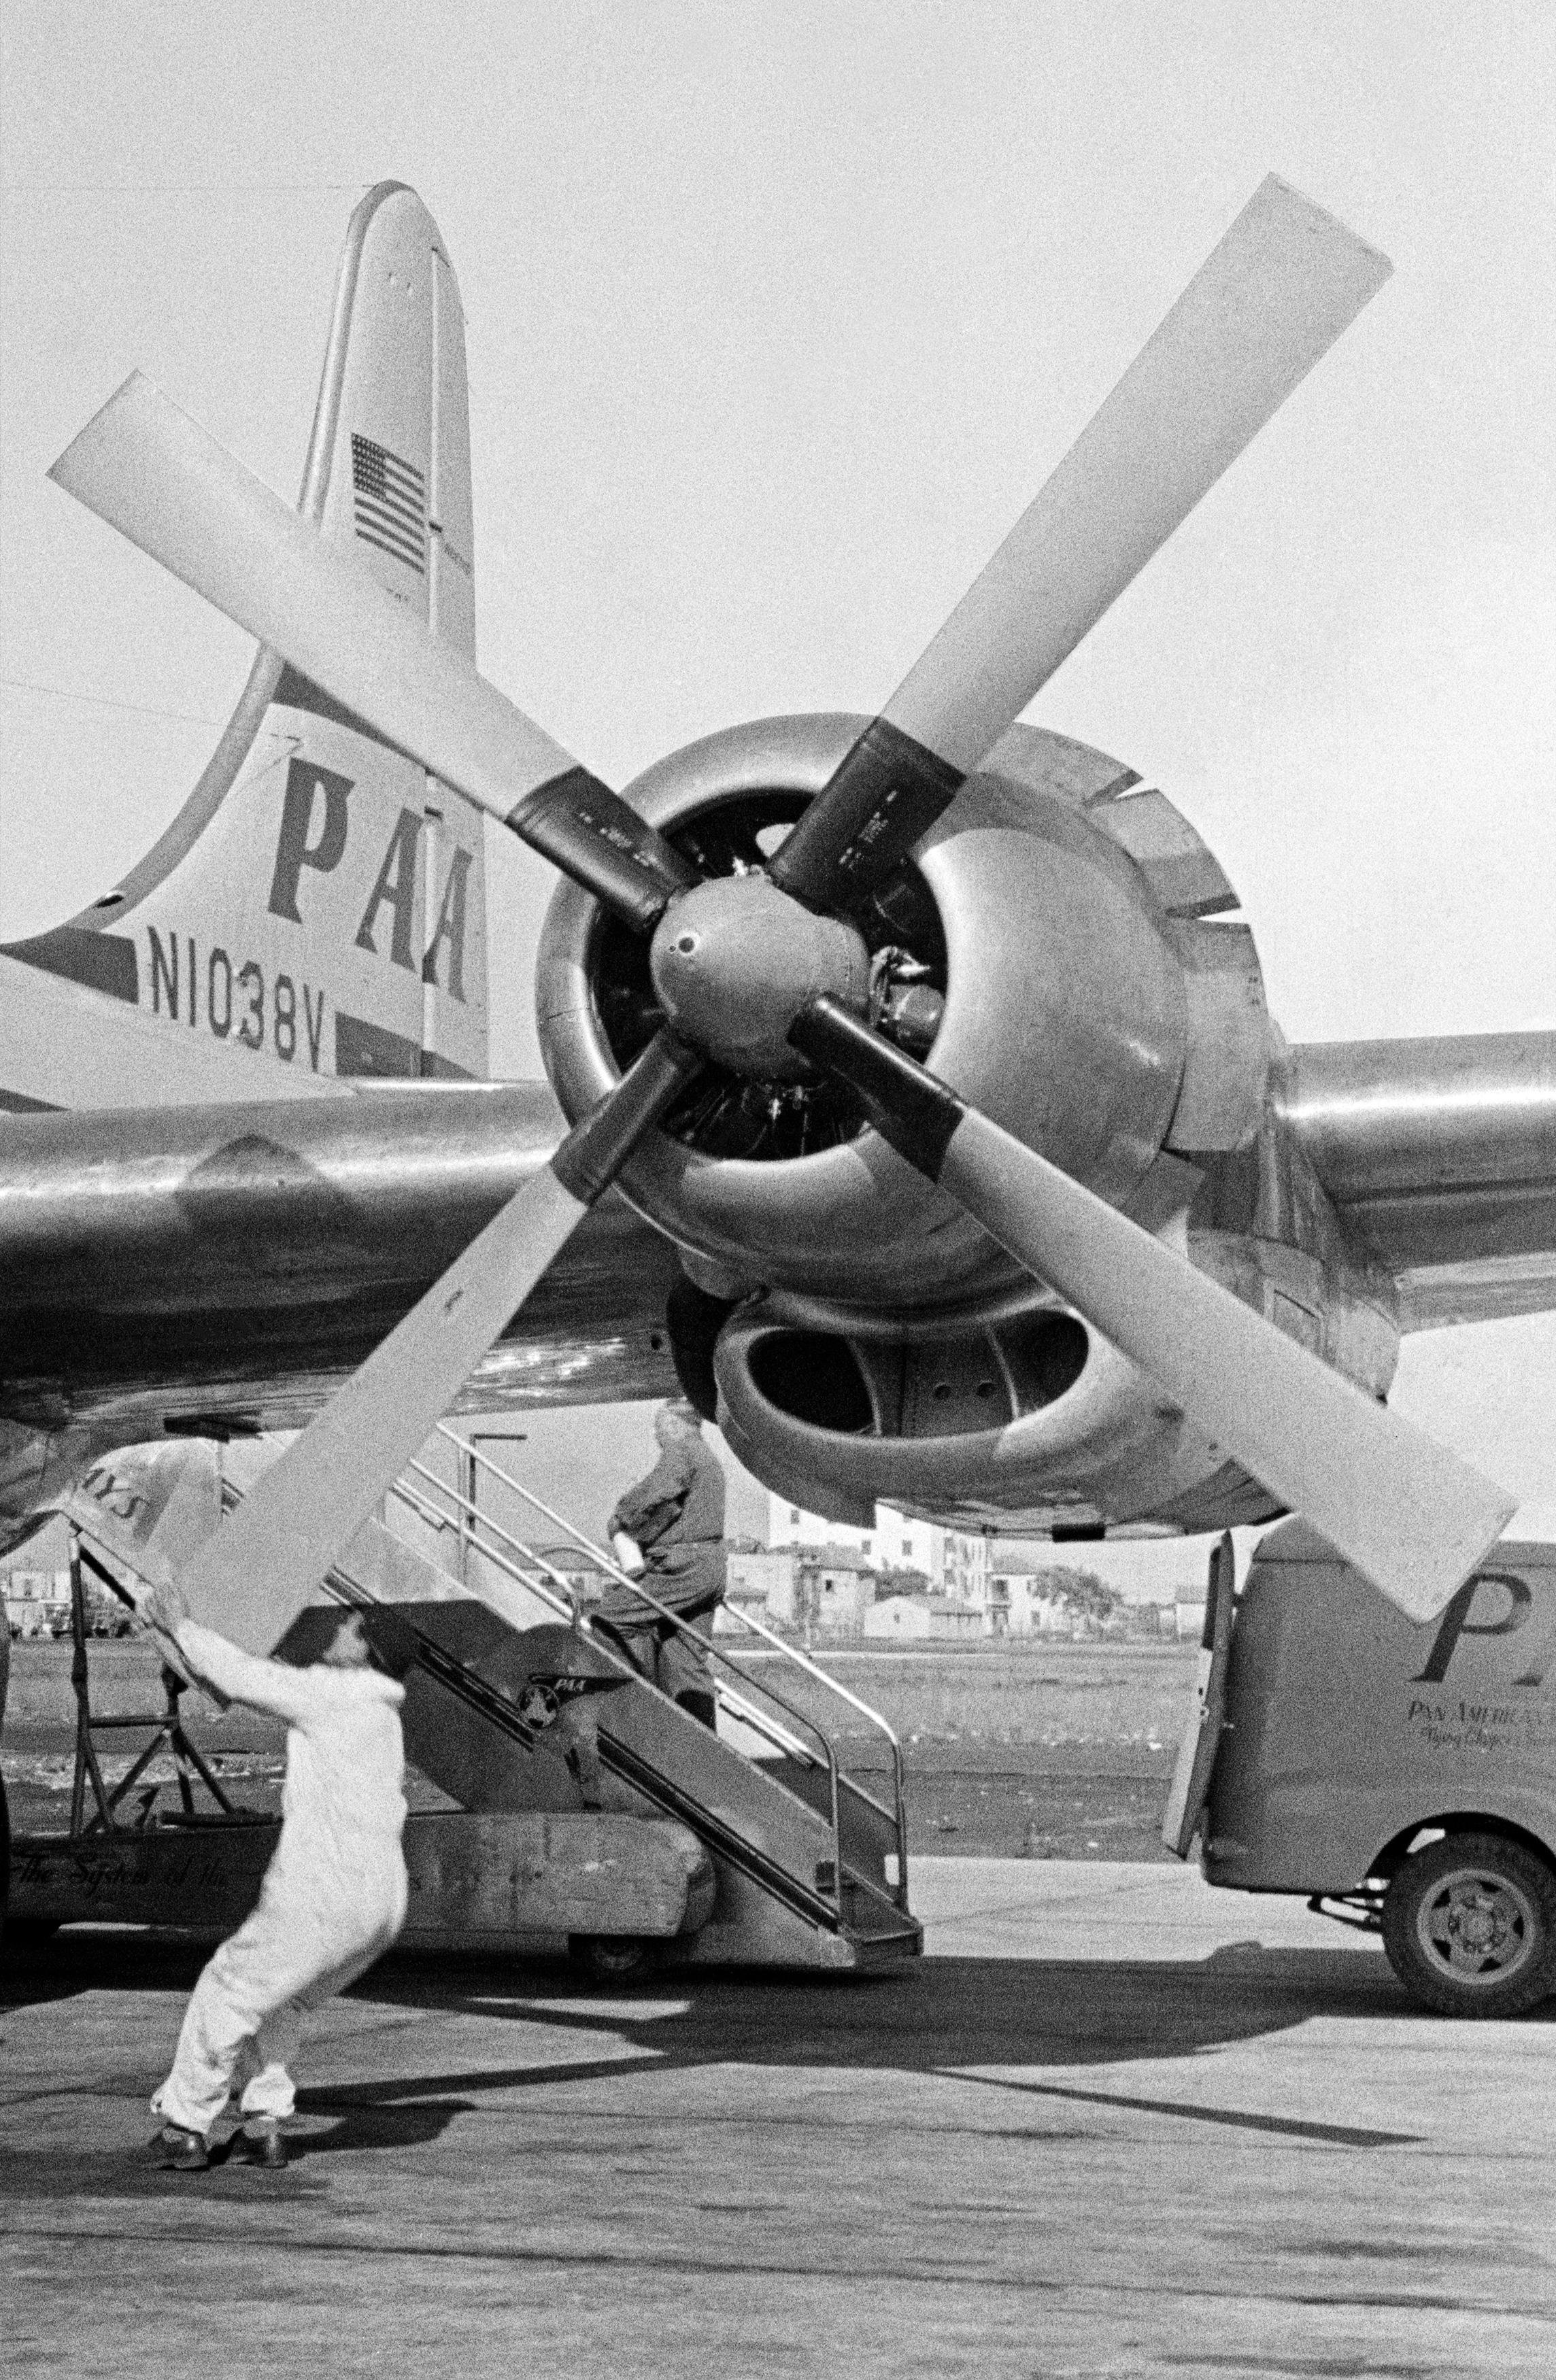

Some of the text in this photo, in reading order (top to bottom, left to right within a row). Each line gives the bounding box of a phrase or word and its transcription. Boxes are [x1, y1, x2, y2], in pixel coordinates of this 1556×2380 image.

[268, 757, 473, 1004] PAA
[147, 925, 324, 1072] N1038V
[554, 1678, 586, 1692] PAA
